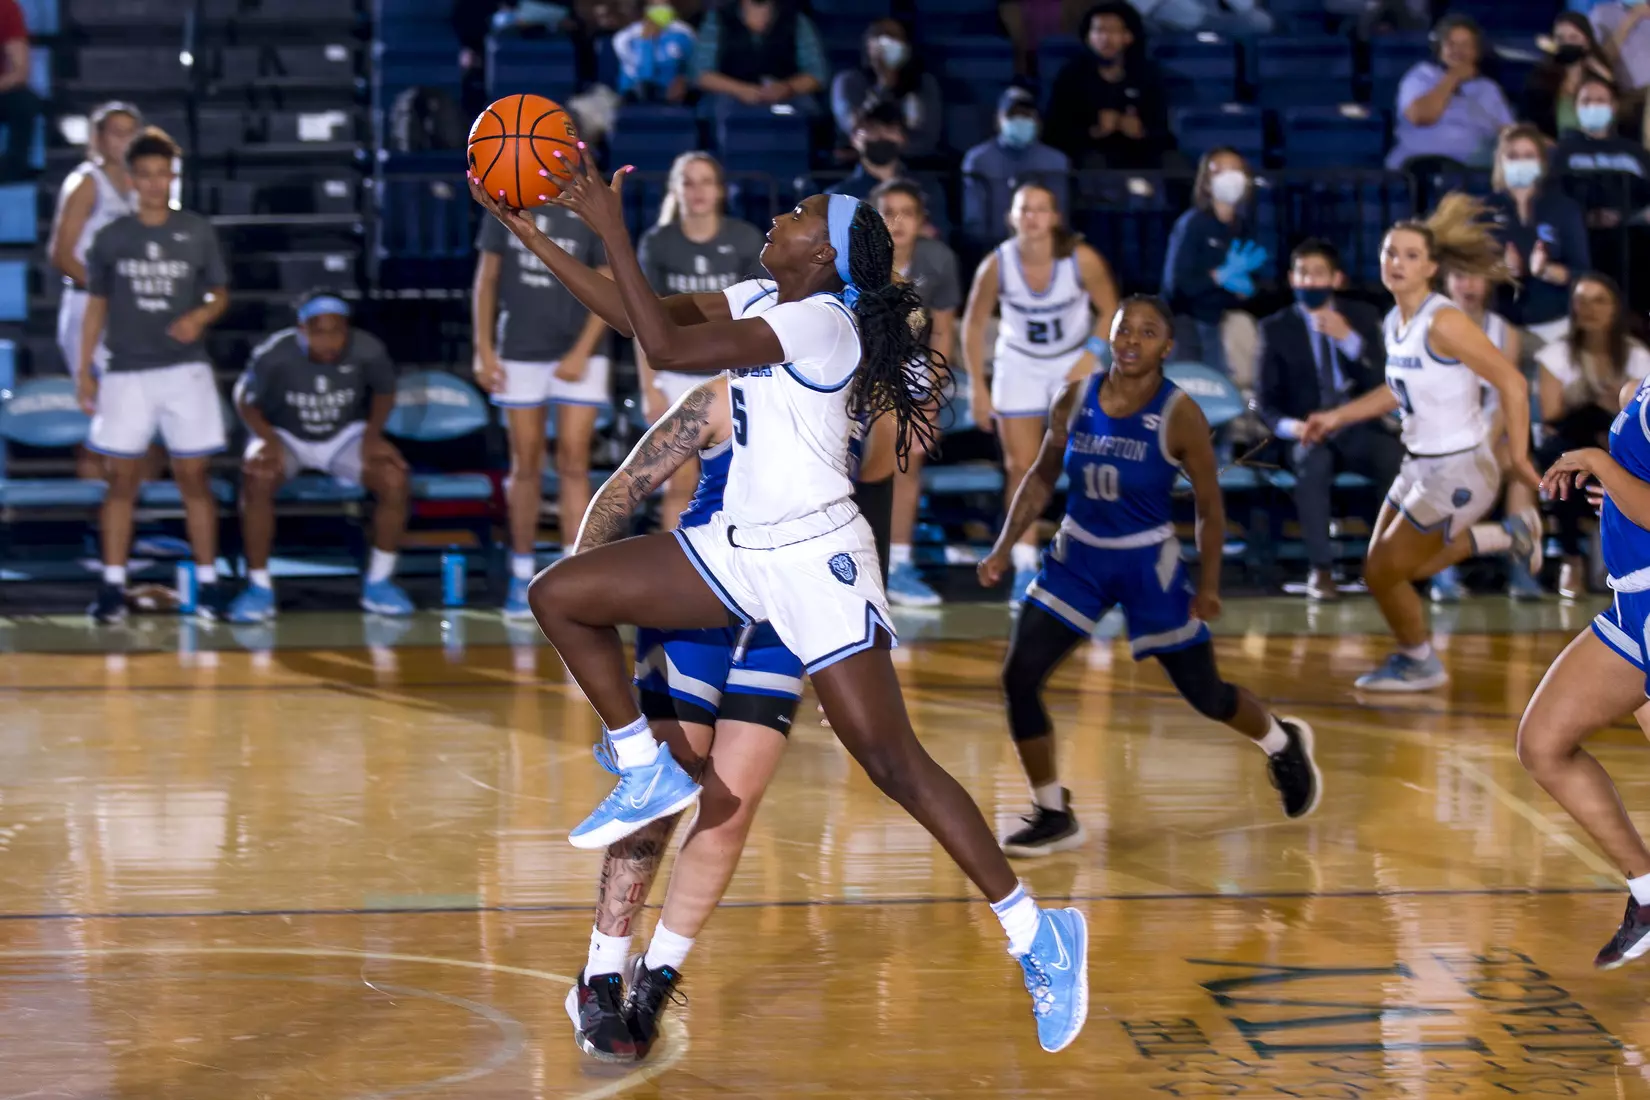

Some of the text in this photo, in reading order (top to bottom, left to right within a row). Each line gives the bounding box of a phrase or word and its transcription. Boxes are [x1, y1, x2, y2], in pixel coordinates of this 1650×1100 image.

[1027, 318, 1064, 346] 21
[730, 385, 749, 447] 5
[1081, 462, 1119, 502] 10
